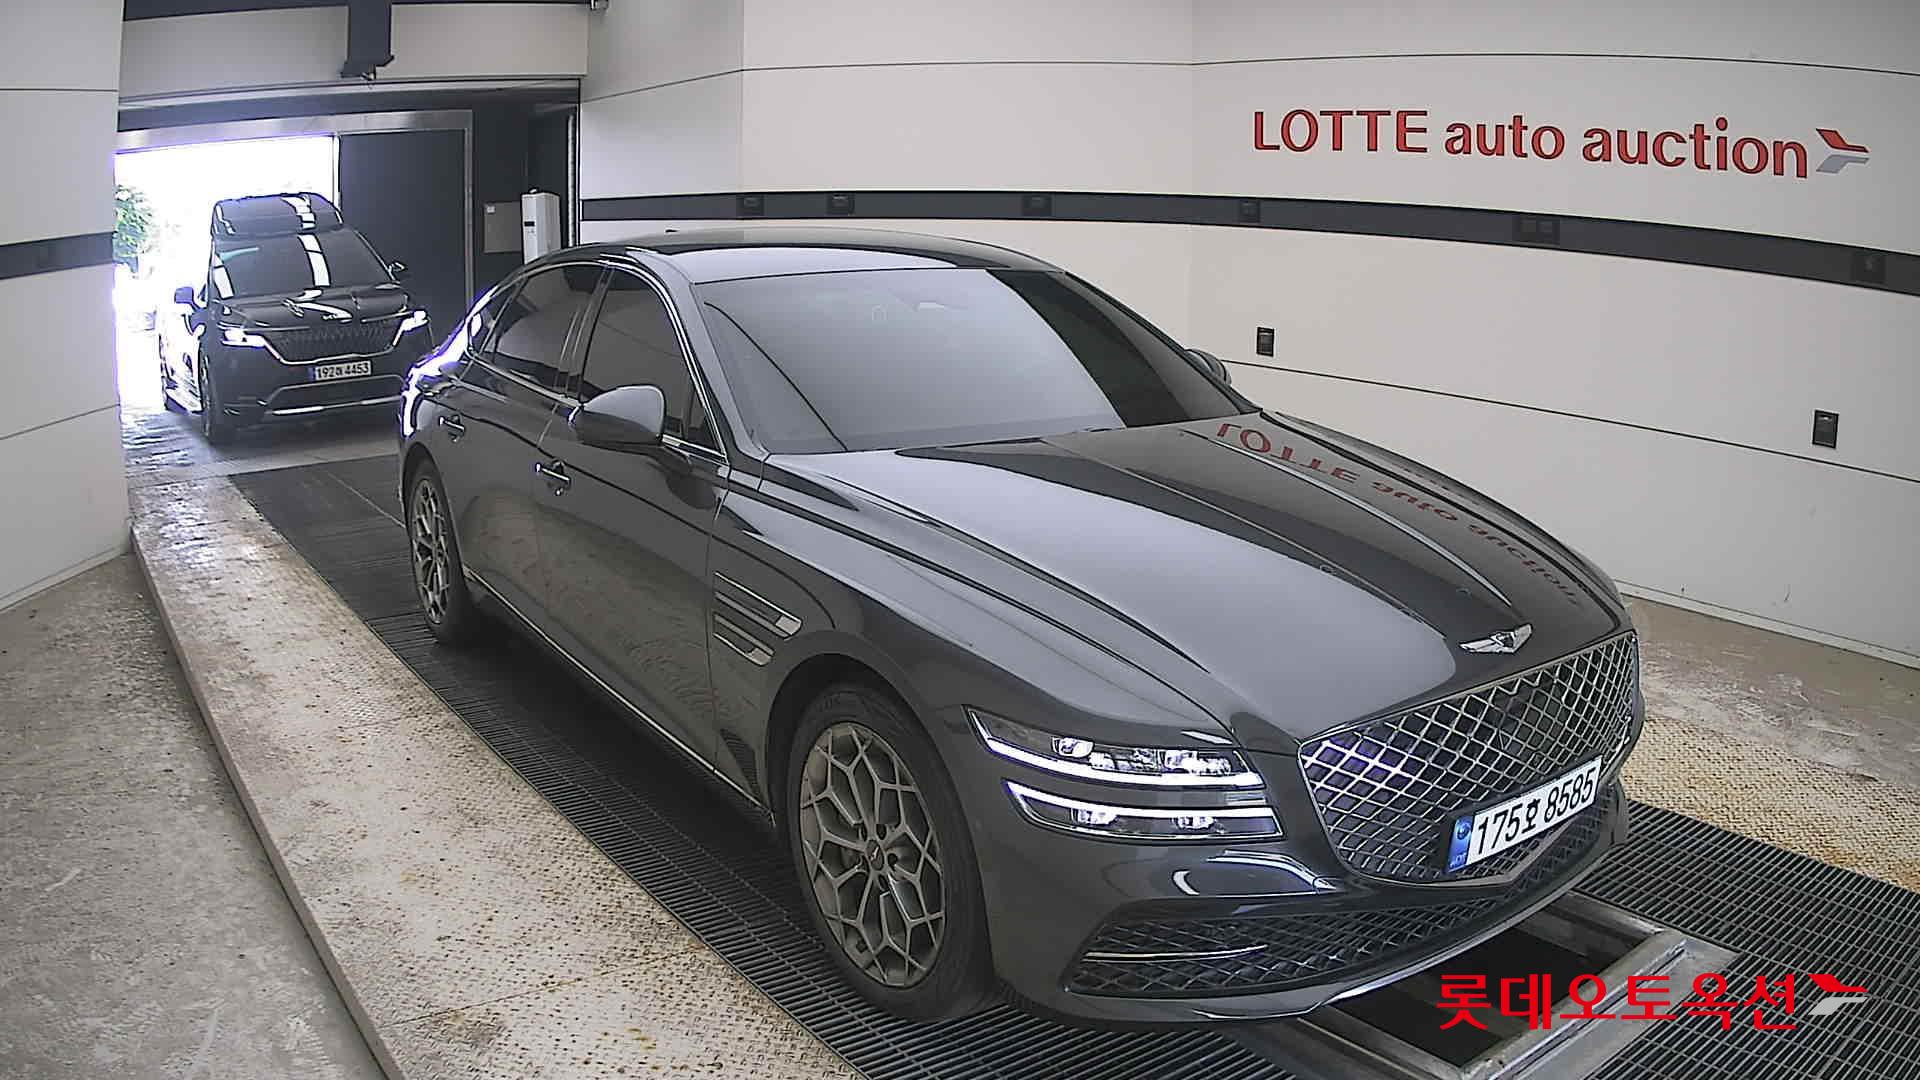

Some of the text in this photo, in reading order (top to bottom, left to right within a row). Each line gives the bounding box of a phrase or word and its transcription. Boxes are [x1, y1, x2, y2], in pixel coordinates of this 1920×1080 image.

[1253, 110, 1808, 179] LOTTE auto auction
[344, 362, 369, 375] 4453
[1478, 766, 1597, 855] 175호 8585
